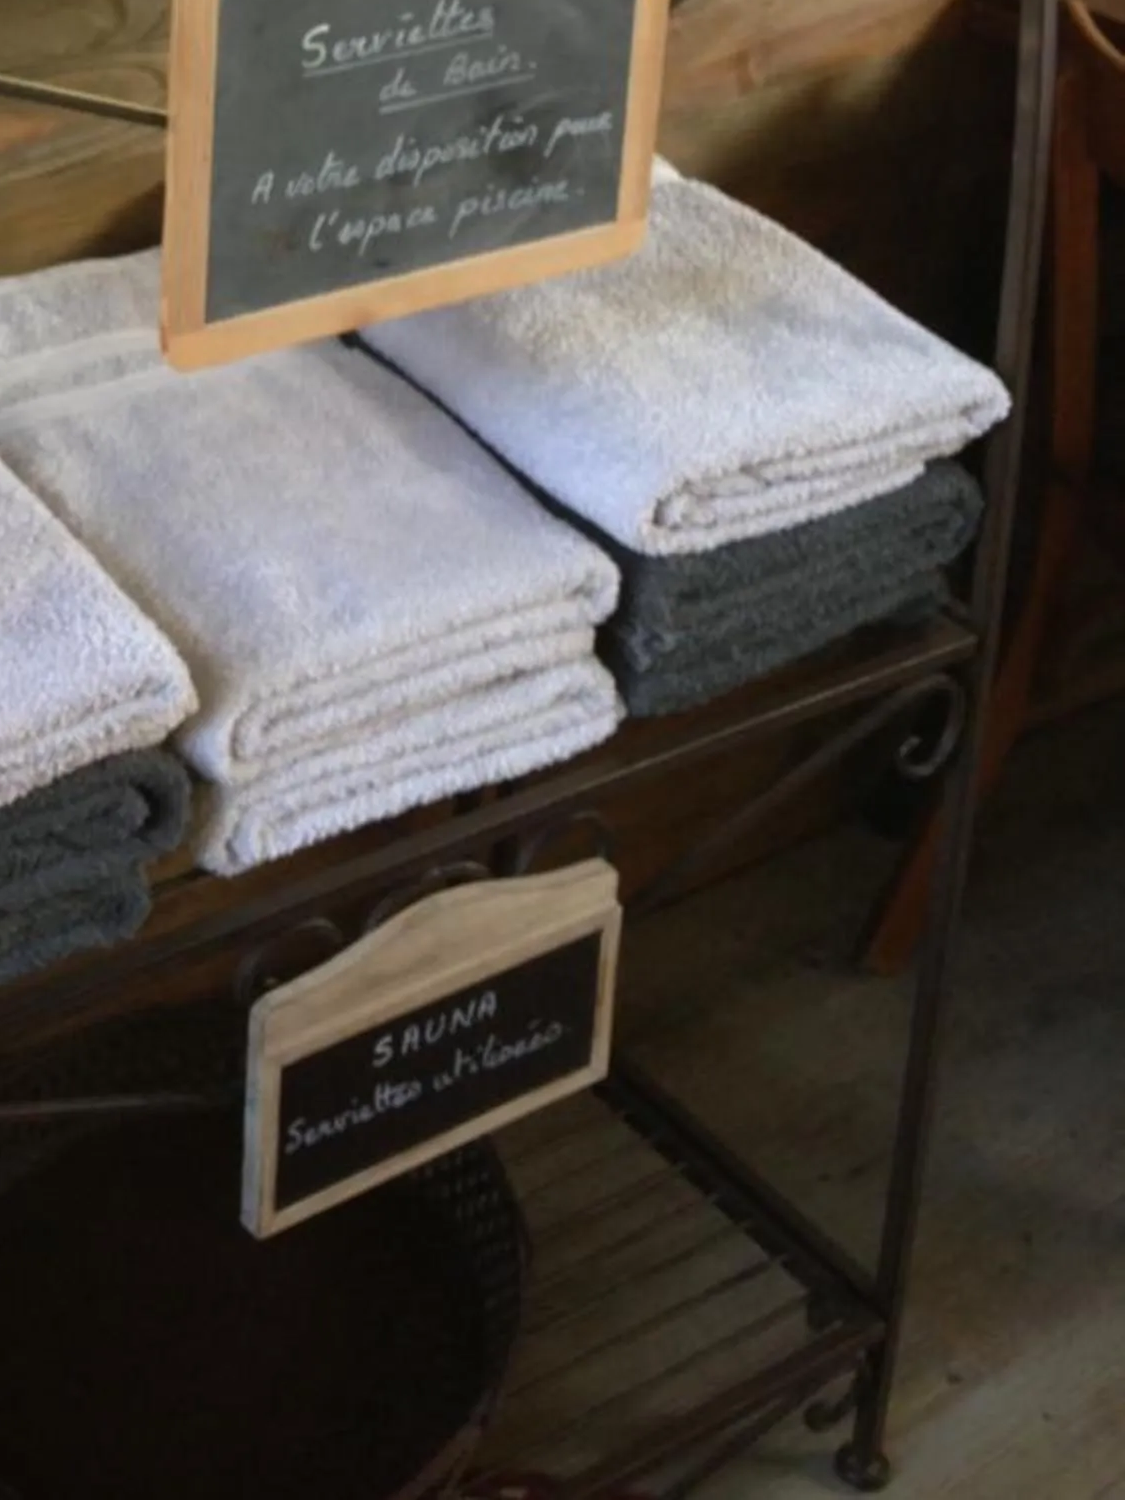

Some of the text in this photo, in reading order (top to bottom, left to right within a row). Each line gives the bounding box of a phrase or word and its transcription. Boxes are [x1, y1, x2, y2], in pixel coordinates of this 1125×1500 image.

[378, 68, 417, 100] de
[251, 172, 275, 204] A
[372, 990, 498, 1068] SAUNA
[285, 1079, 423, 1156] Serviettes
